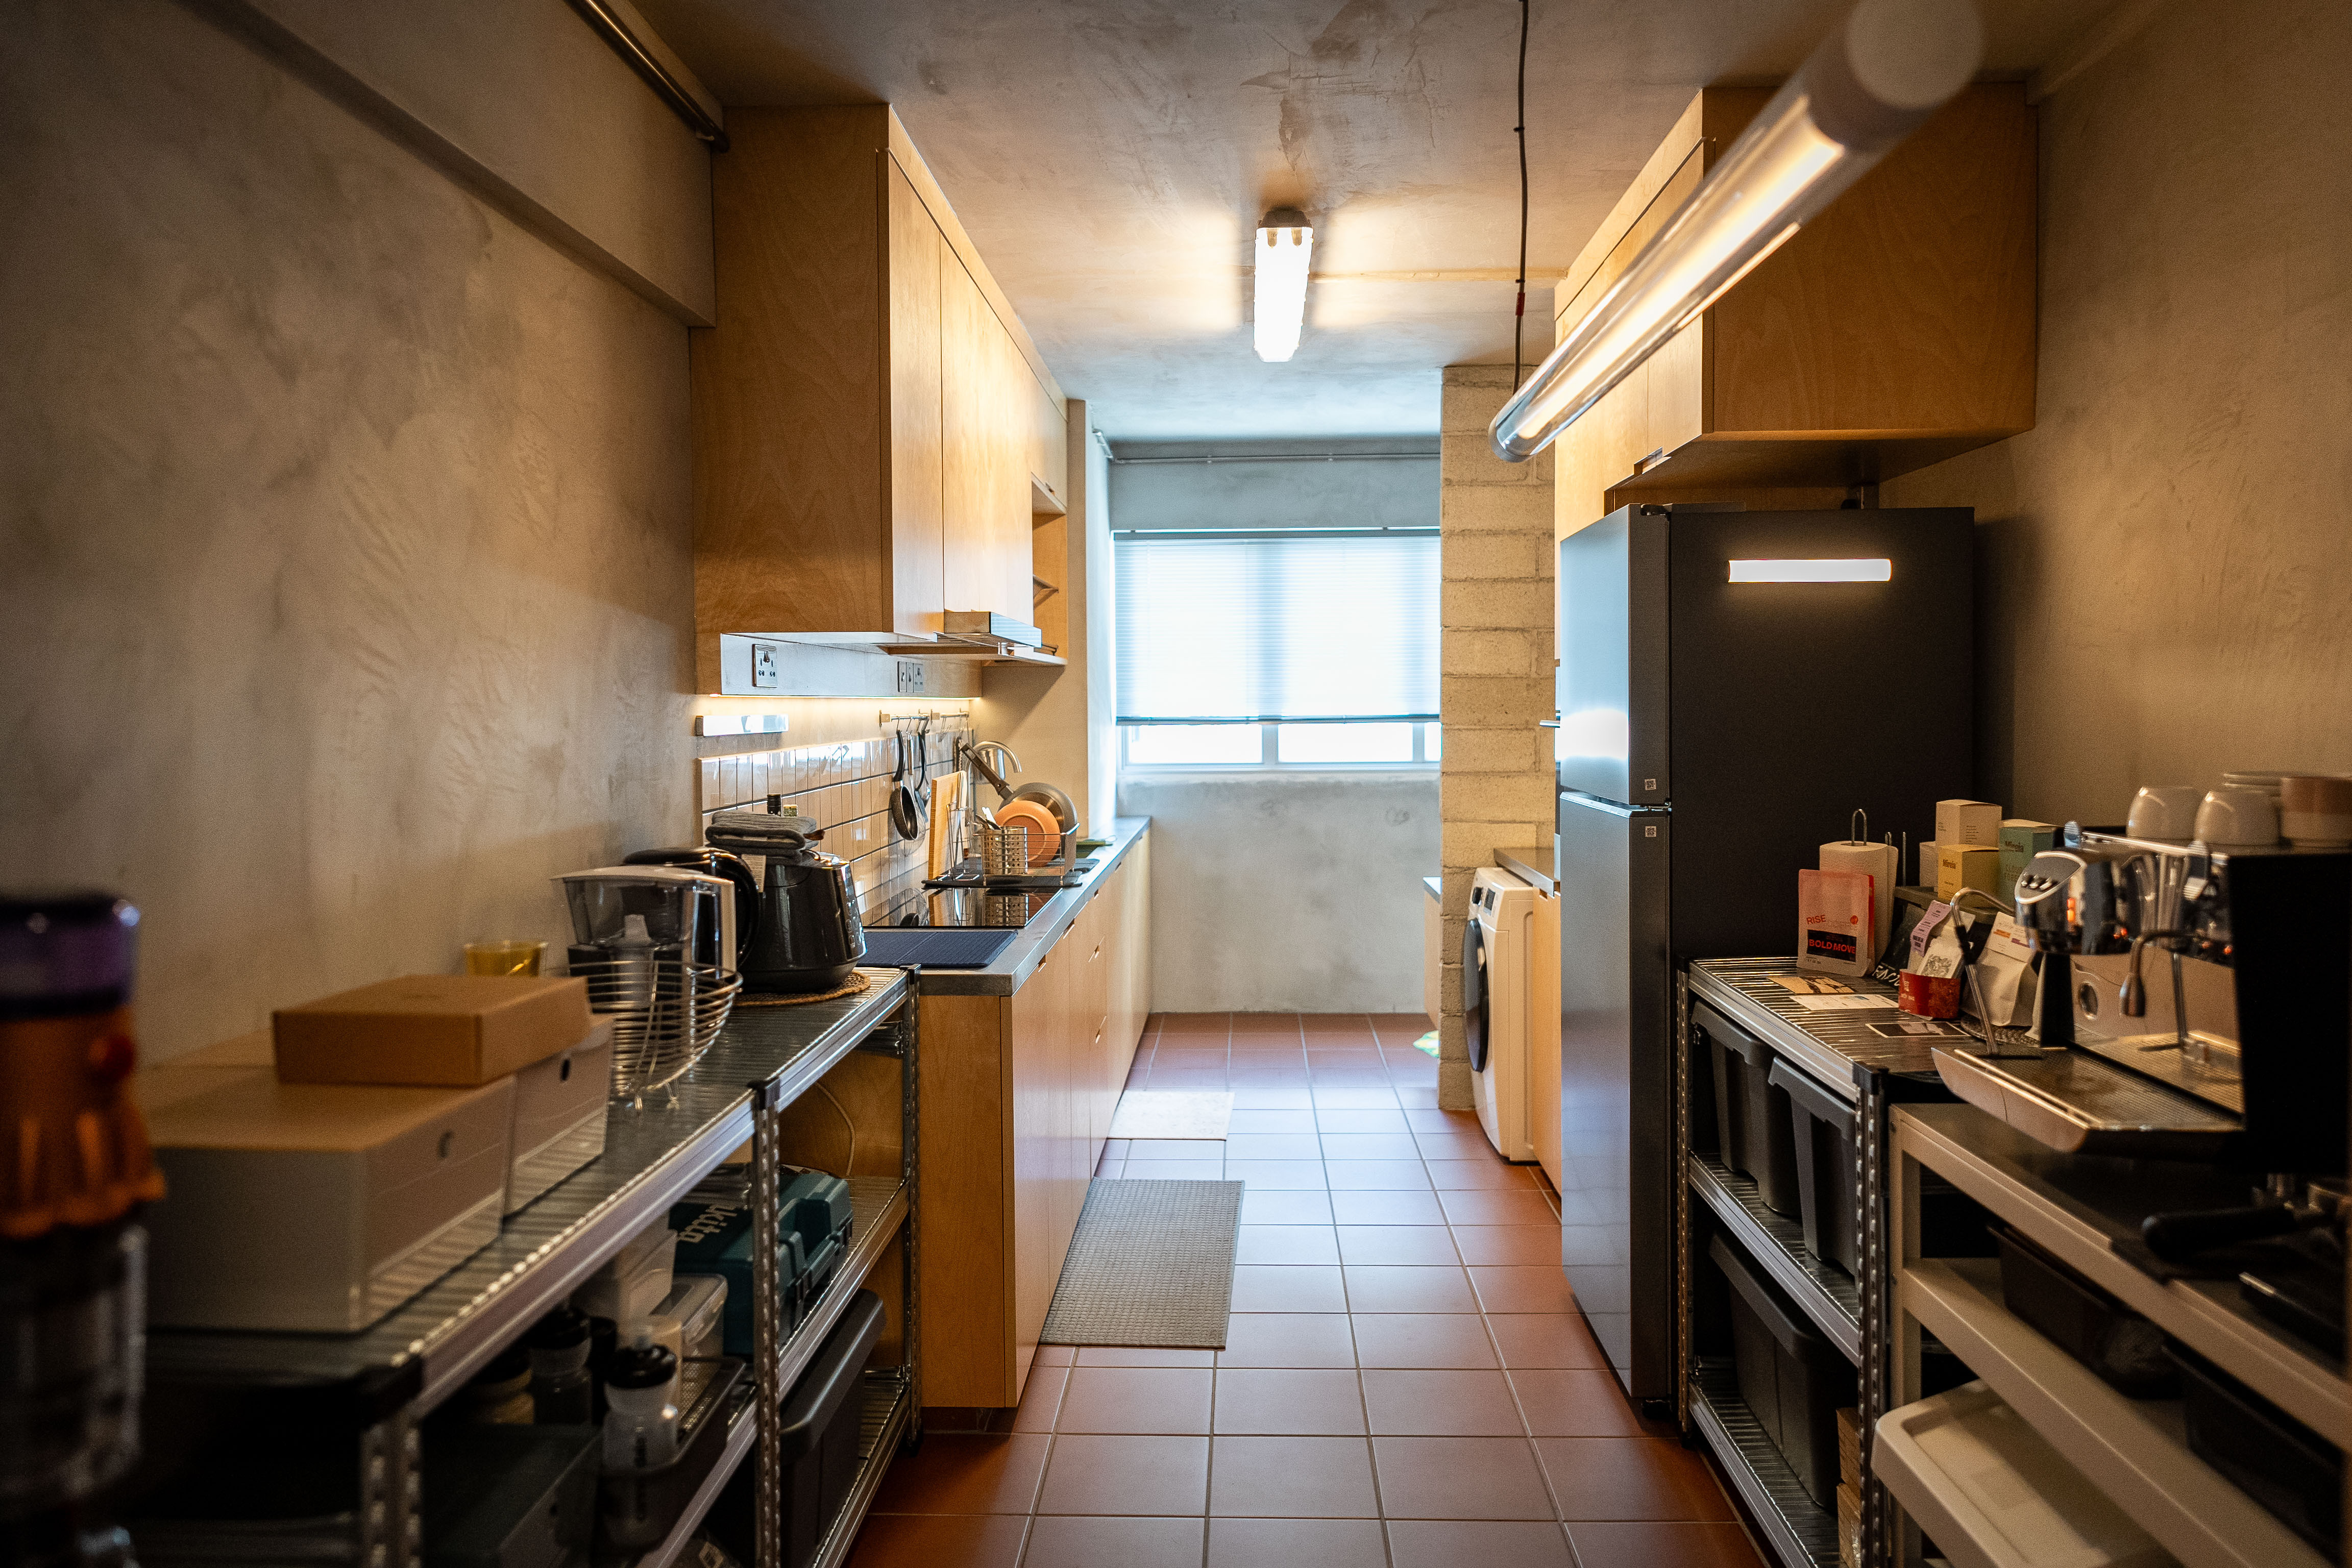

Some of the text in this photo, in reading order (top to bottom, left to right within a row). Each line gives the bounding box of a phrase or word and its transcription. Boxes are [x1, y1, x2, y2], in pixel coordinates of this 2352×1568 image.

[1806, 915, 1826, 925] RISE
[1809, 939, 1856, 953] BOLD MOVE
[679, 1204, 737, 1243] kita
